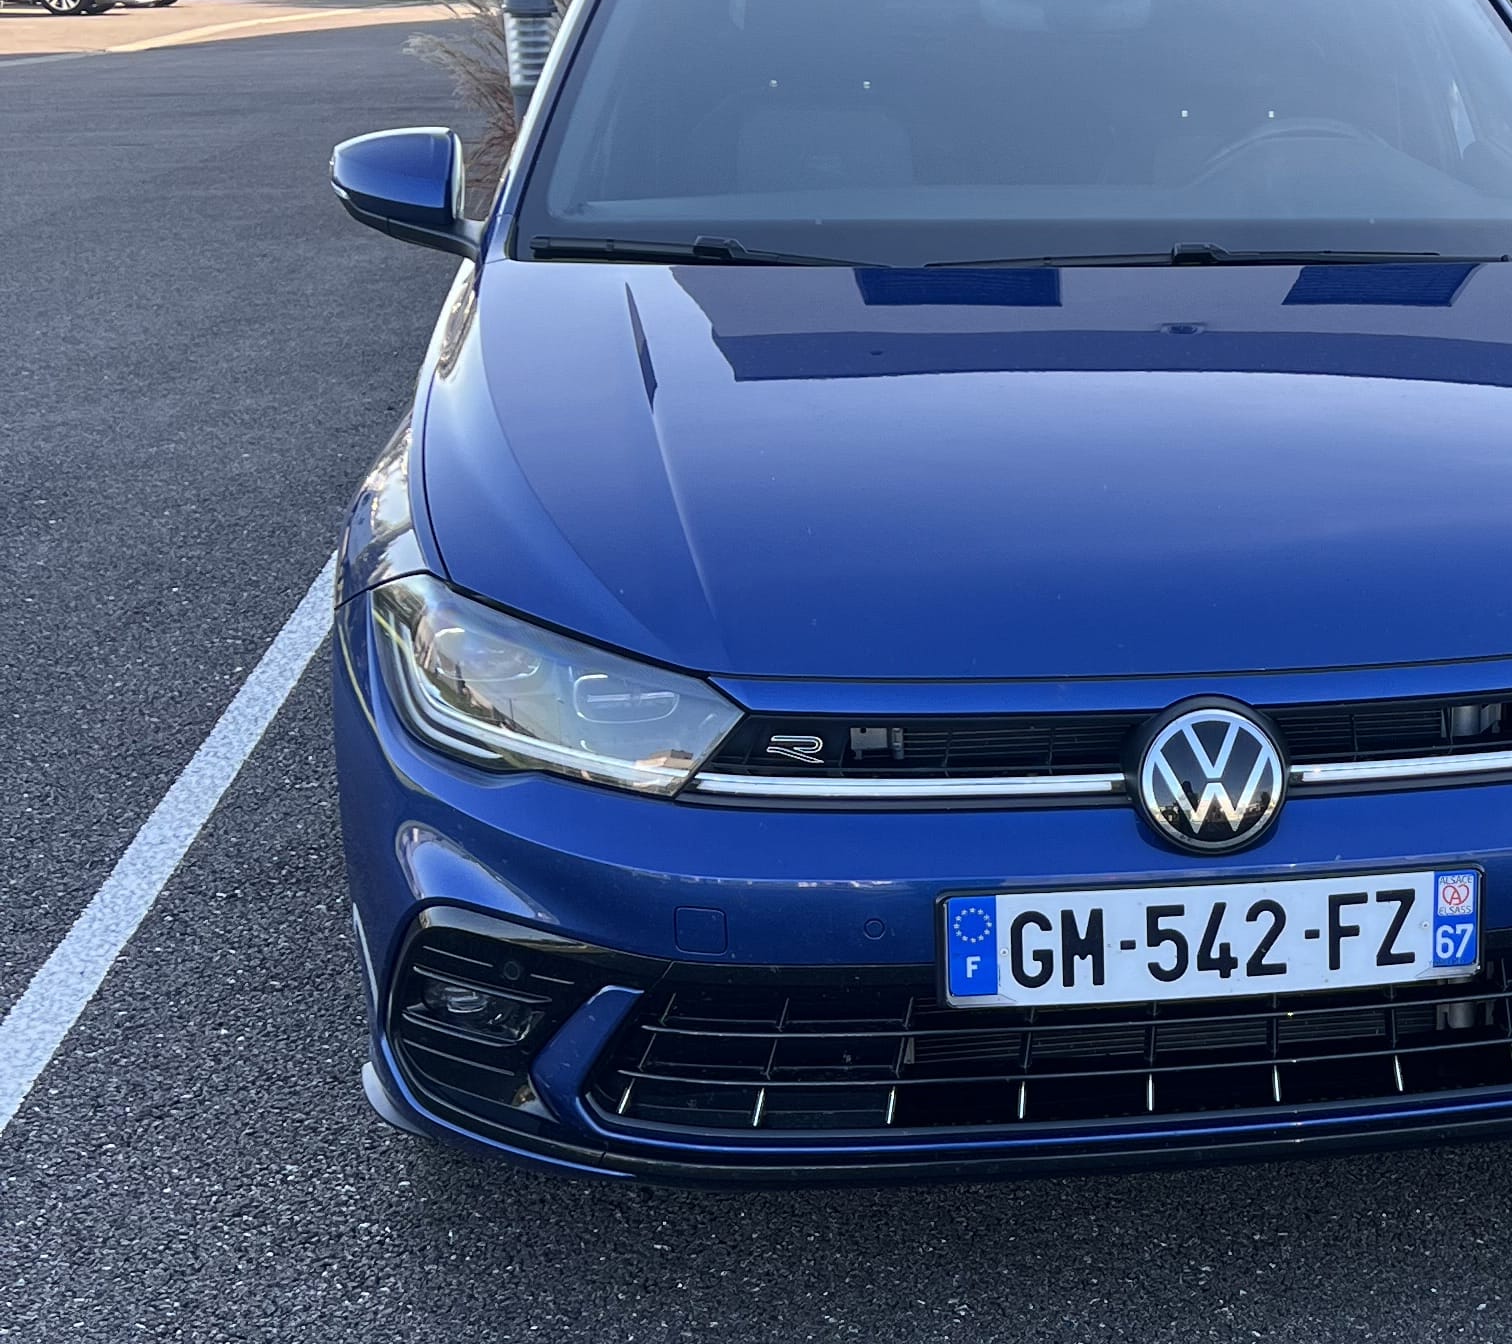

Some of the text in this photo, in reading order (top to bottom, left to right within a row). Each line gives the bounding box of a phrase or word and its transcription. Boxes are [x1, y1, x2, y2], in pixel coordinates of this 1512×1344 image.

[767, 735, 825, 764] R
[1439, 875, 1473, 885] ALSACE
[1438, 905, 1472, 915] ELSASS
[1010, 888, 1416, 989] GM-542-FZ
[1435, 923, 1474, 959] 67
[966, 956, 982, 978] F
